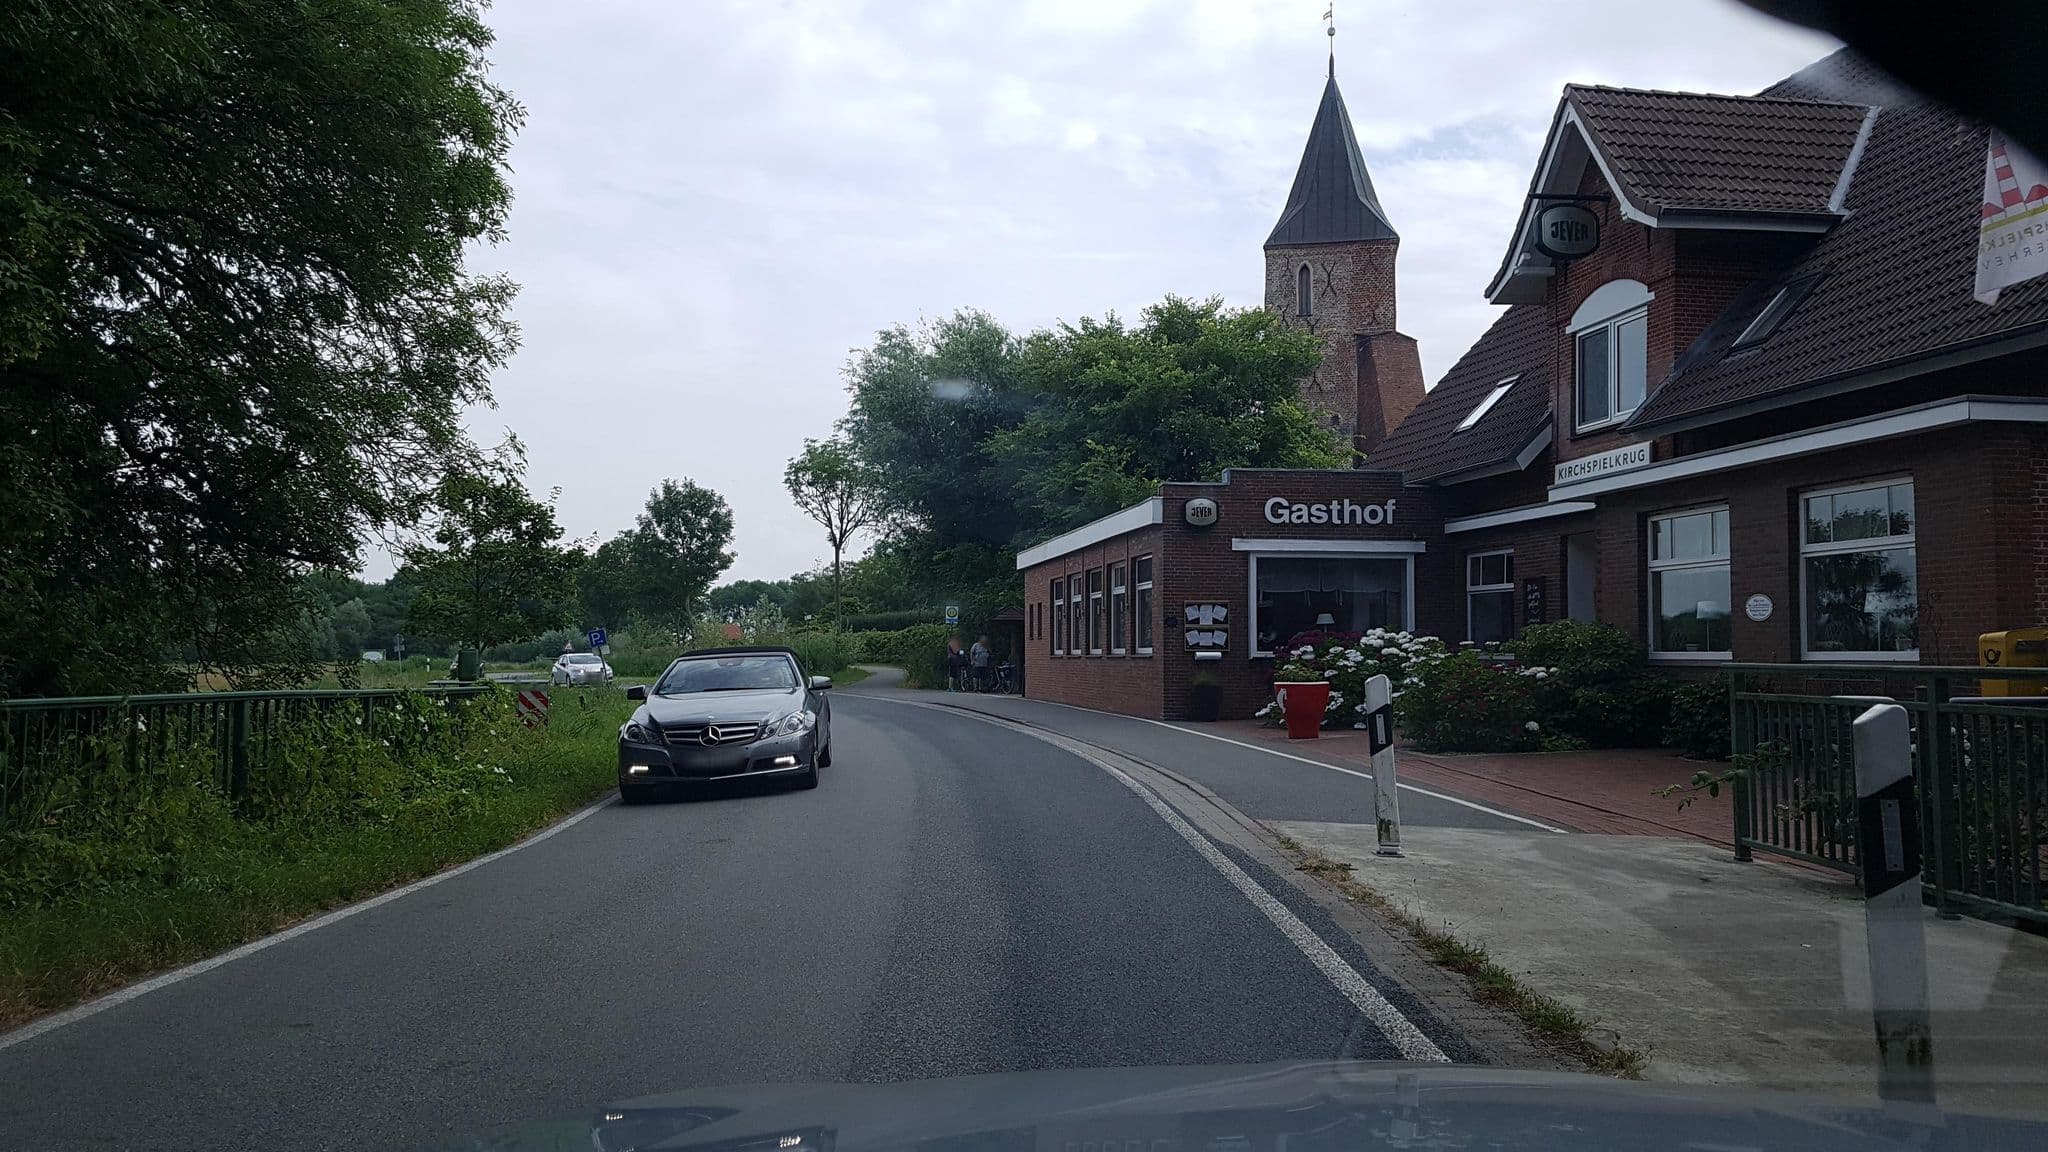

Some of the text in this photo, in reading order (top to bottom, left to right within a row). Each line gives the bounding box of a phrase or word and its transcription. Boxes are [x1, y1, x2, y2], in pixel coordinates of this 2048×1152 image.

[1551, 220, 1589, 242] JEVER
[1558, 449, 1645, 480] KIRCHSPIELKRUG
[1191, 506, 1212, 518] JEVER
[1264, 497, 1397, 524] Gasthof
